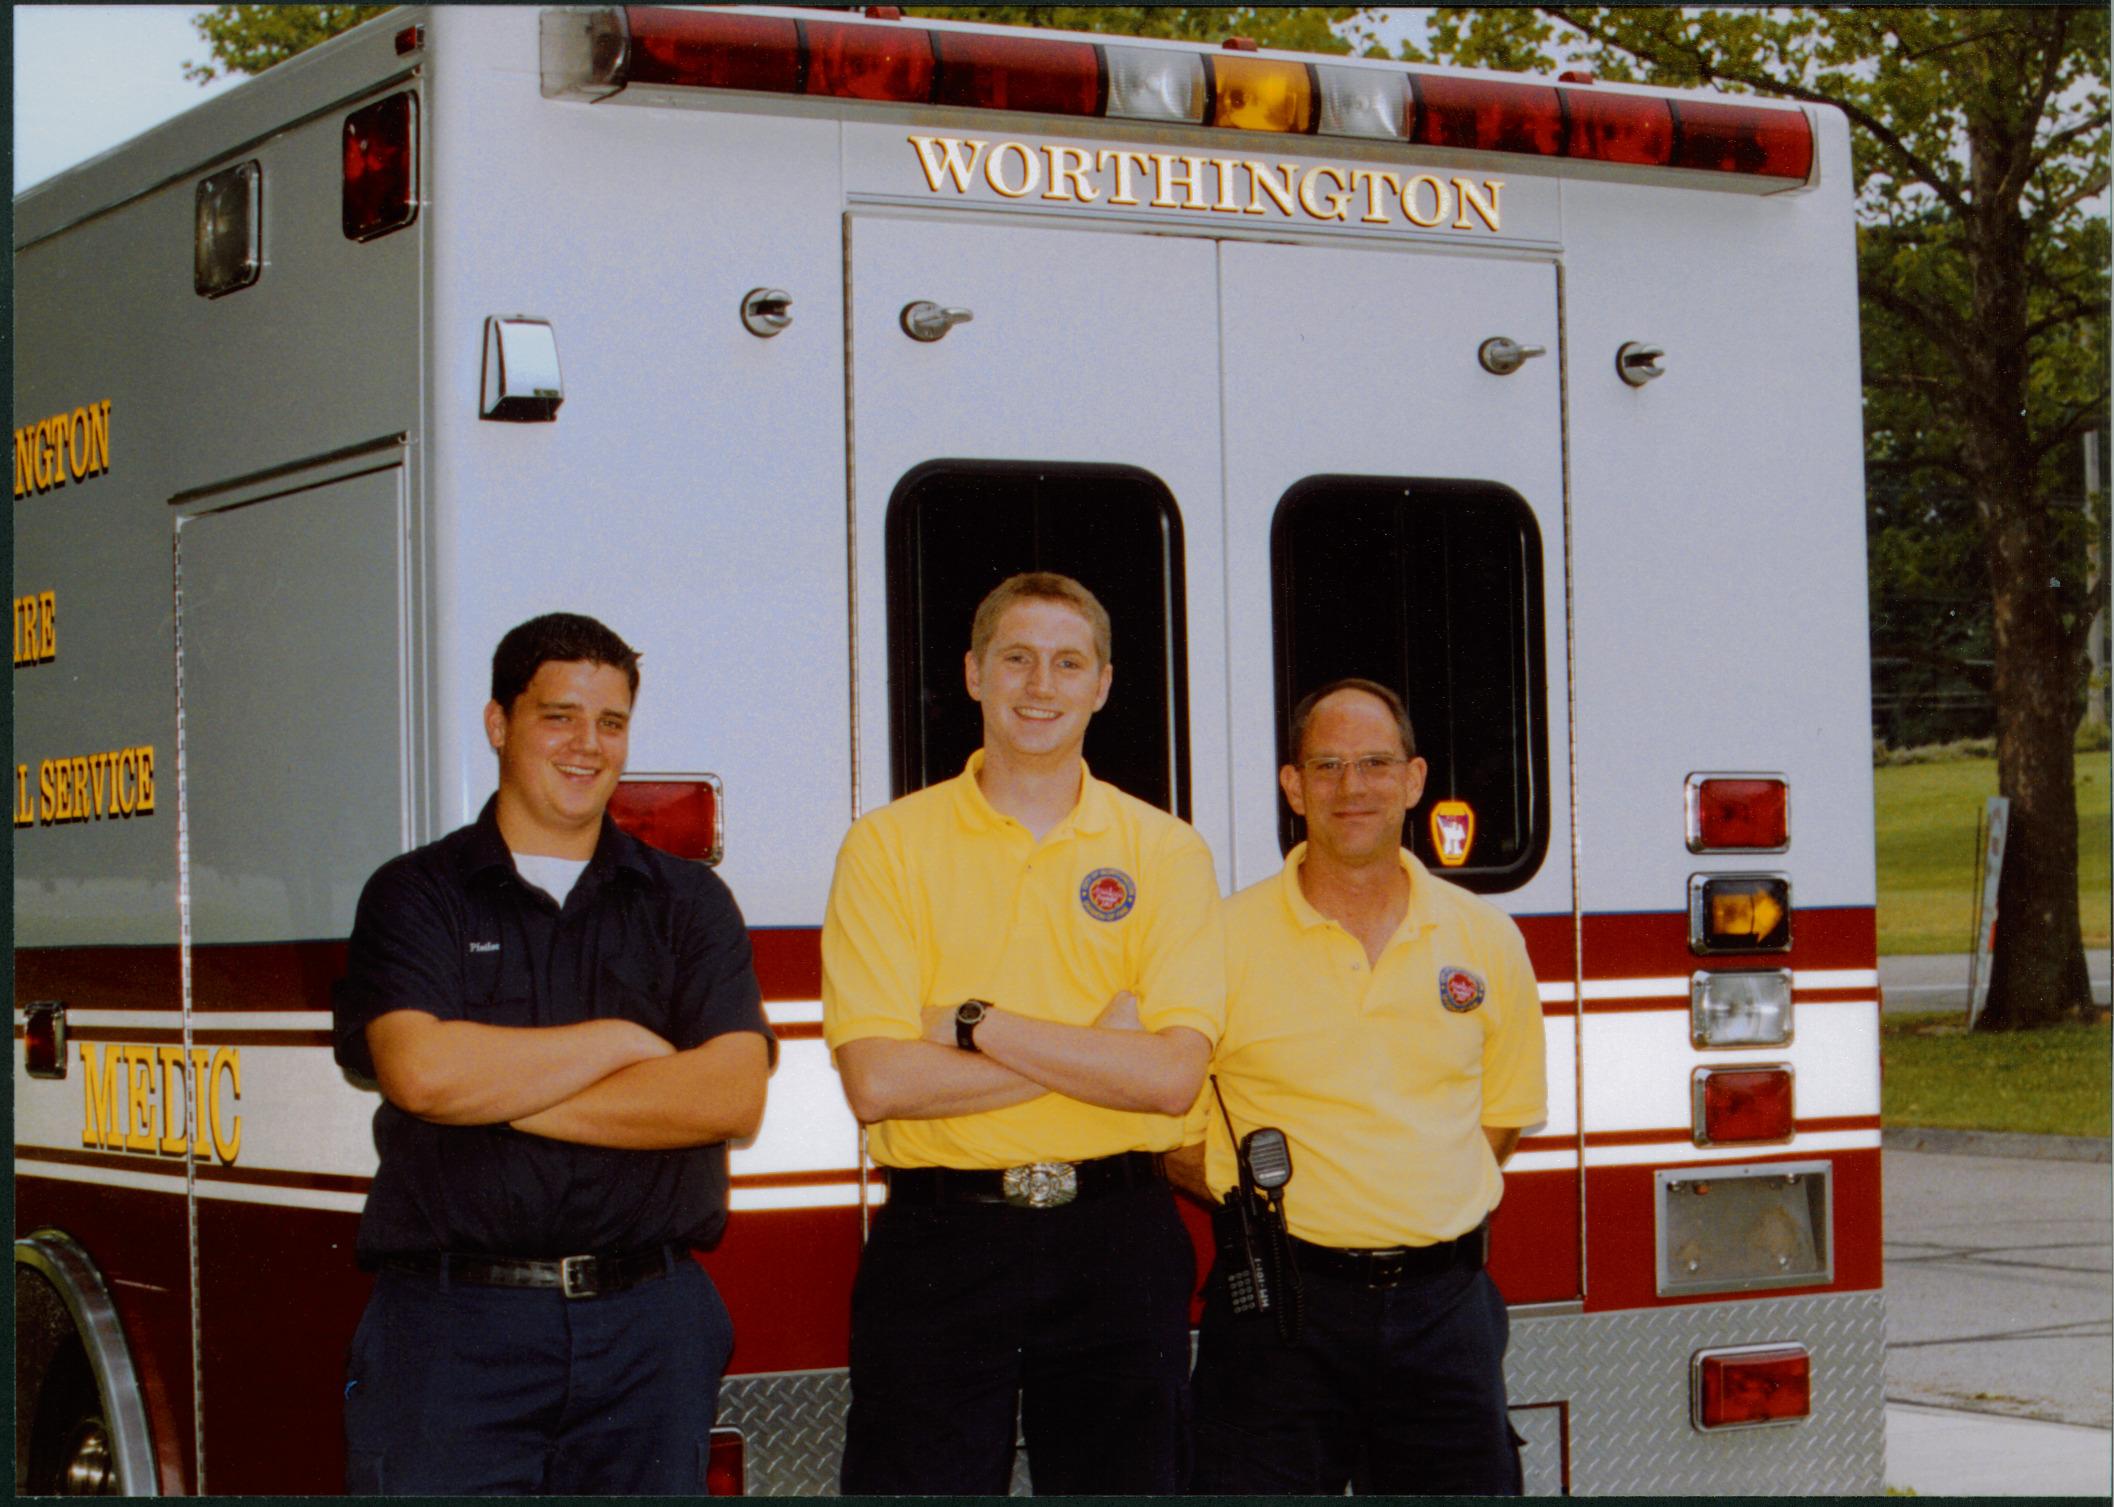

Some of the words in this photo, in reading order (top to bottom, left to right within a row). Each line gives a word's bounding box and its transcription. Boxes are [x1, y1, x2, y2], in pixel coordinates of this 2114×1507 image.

[907, 134, 1504, 232] WORTHINGTON
[14, 397, 111, 501] NGTON
[40, 745, 154, 827] SERVICE
[79, 1042, 242, 1167] MEDIC
